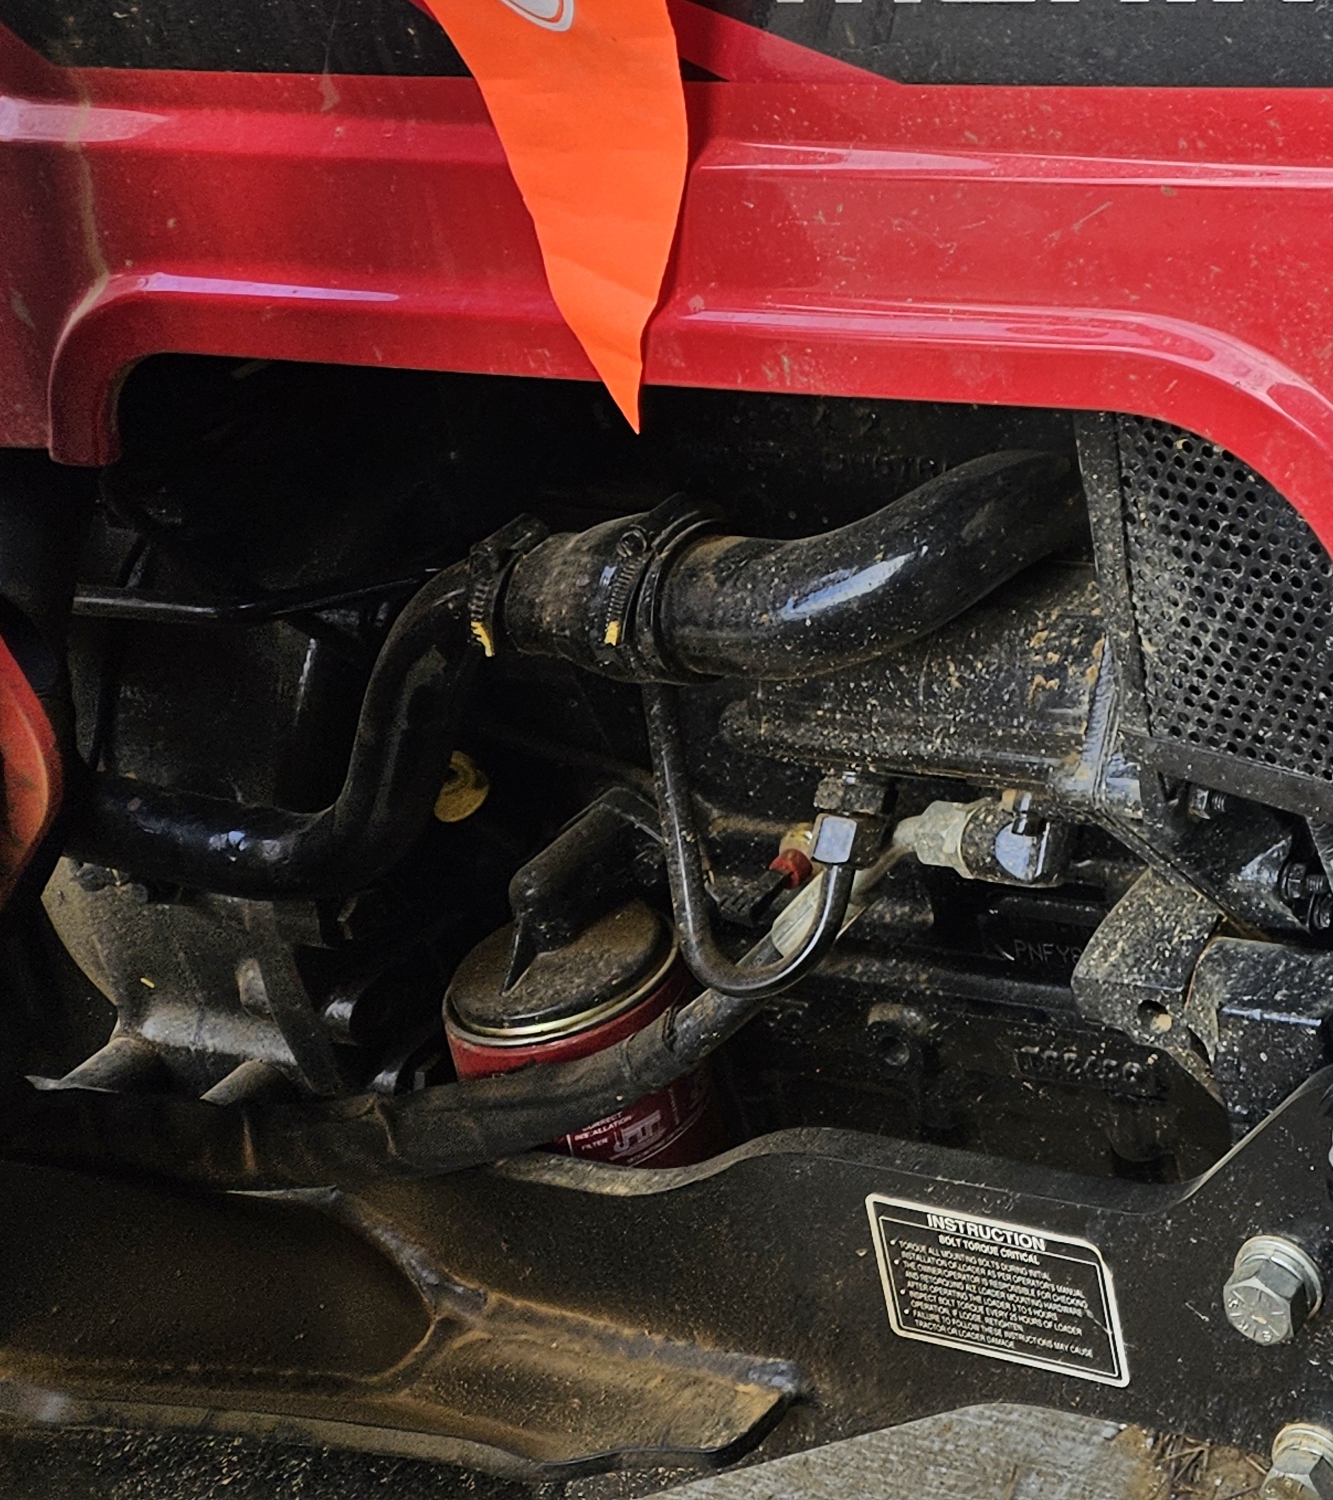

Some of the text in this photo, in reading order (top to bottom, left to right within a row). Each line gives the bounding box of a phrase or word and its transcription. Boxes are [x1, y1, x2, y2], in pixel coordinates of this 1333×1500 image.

[925, 1213, 1046, 1252] INSTRUCTION
[937, 1233, 1041, 1266] BOLT TORQUE CRITICAL
